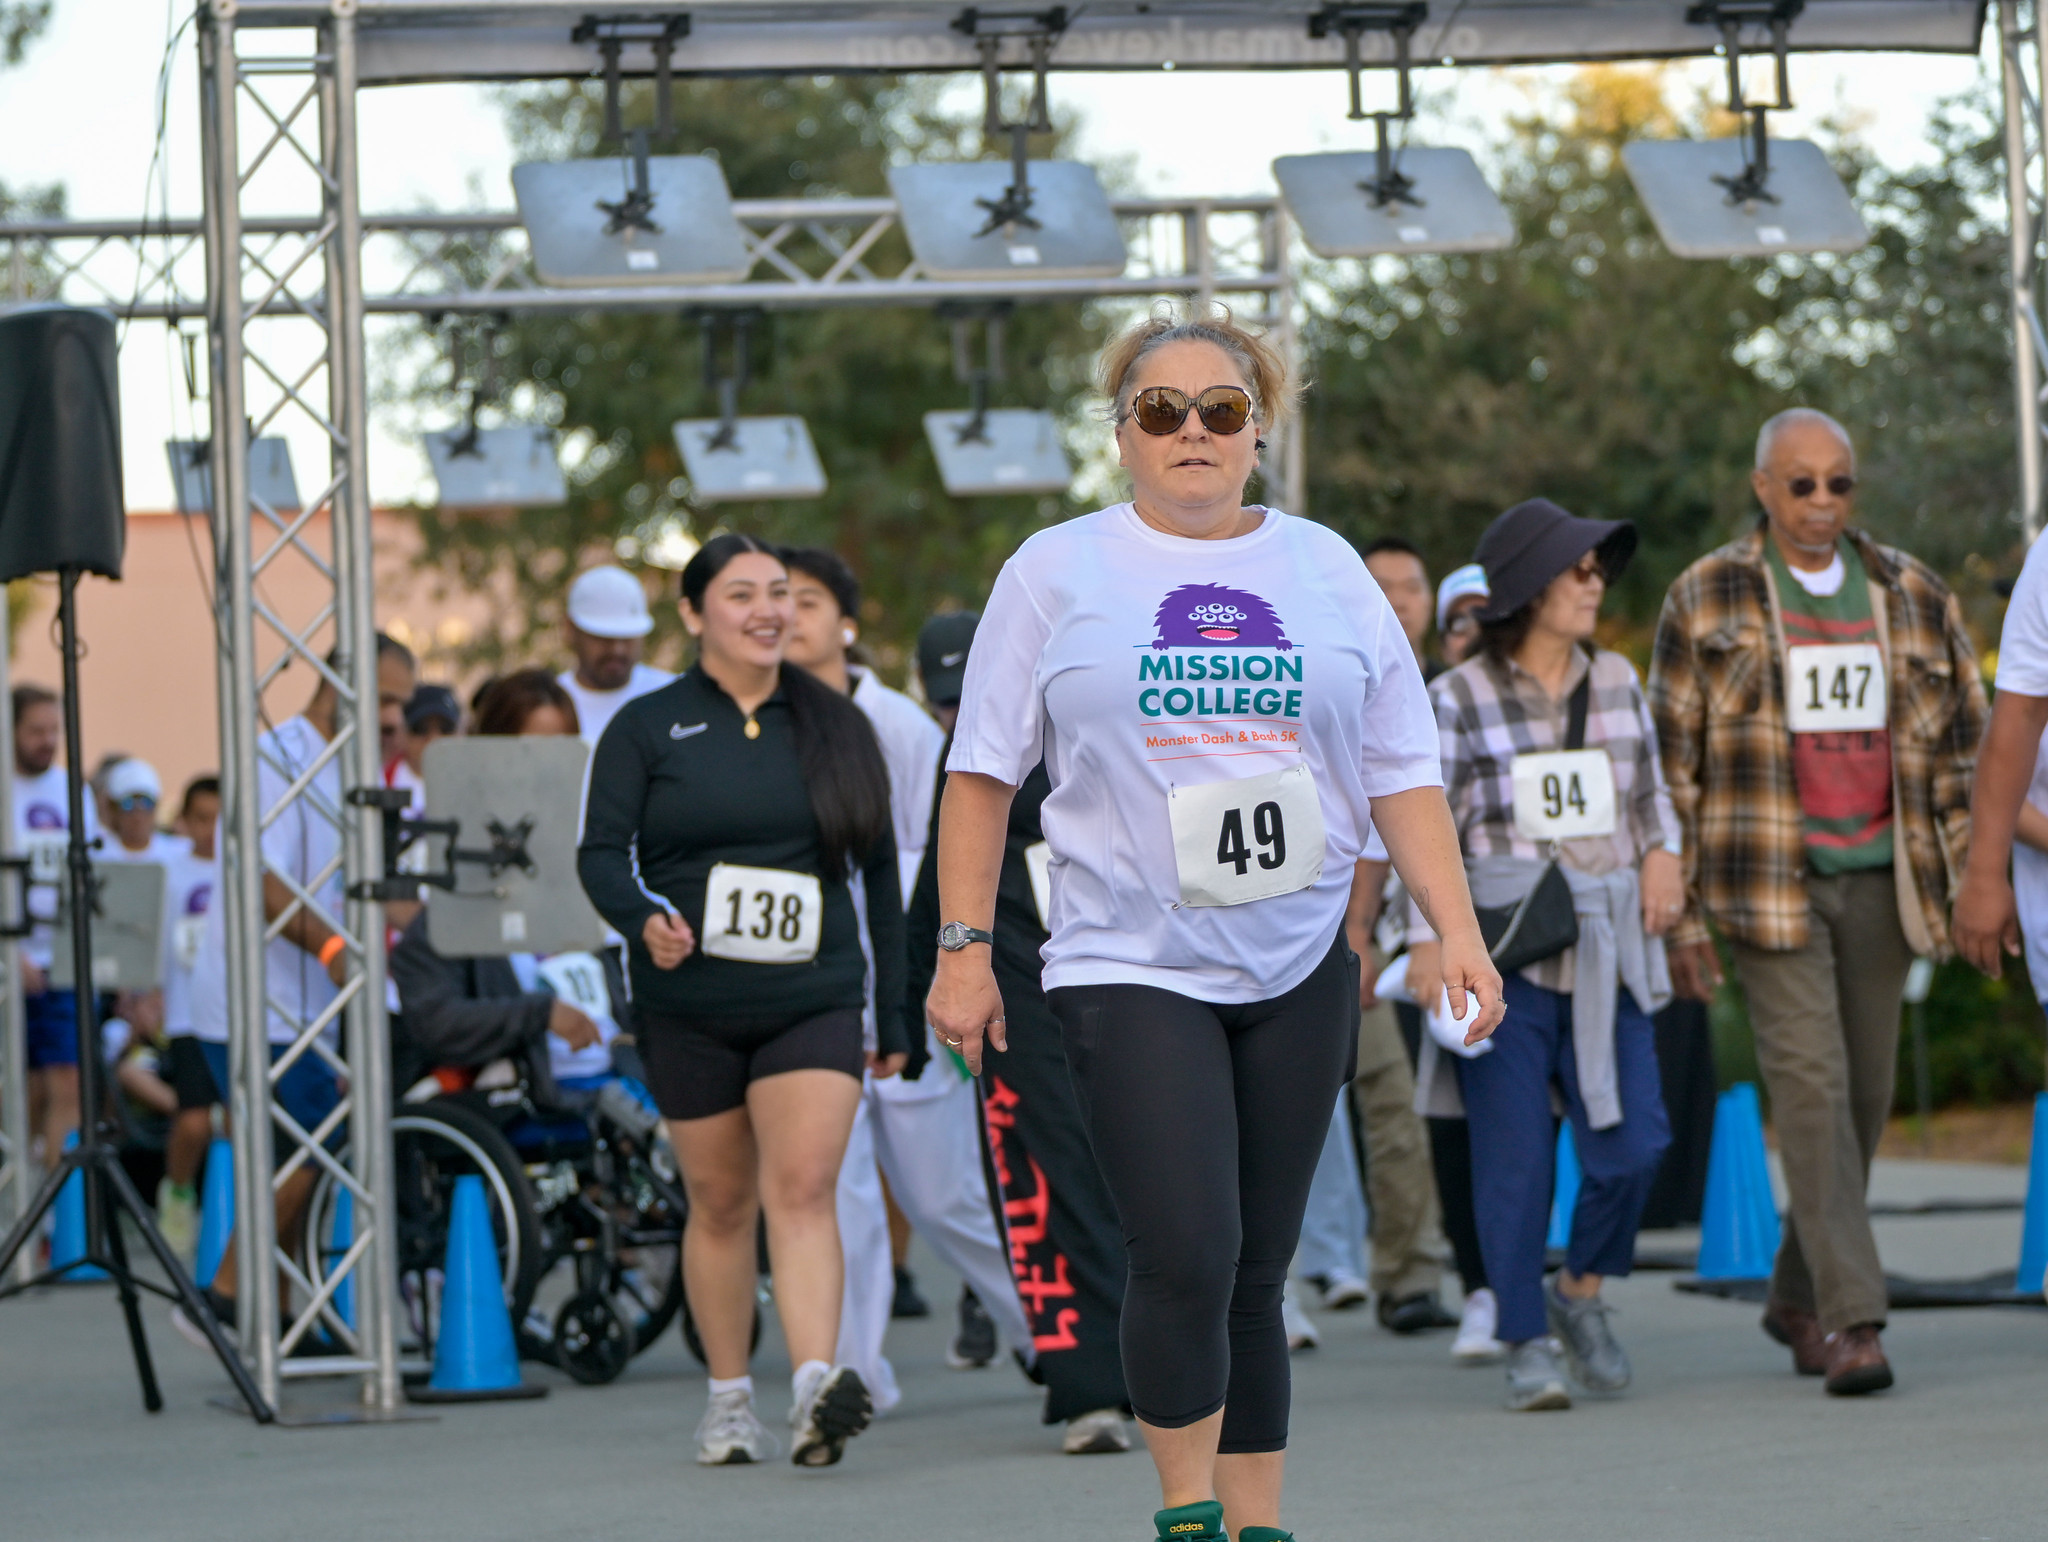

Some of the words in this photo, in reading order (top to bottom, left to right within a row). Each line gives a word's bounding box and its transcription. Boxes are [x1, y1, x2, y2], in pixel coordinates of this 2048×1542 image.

[1138, 654, 1303, 682] MISSION
[1804, 664, 1874, 711] 147
[1138, 687, 1303, 718] COLLEGE
[1146, 734, 1199, 748] Monster
[1201, 731, 1234, 745] Dash
[1238, 731, 1249, 743] &
[1251, 729, 1278, 743] Bash
[1281, 730, 1298, 742] 5K
[1541, 771, 1588, 820] 94
[1217, 800, 1287, 876] 49
[724, 888, 803, 943] 138
[1169, 1522, 1204, 1534] adidas
